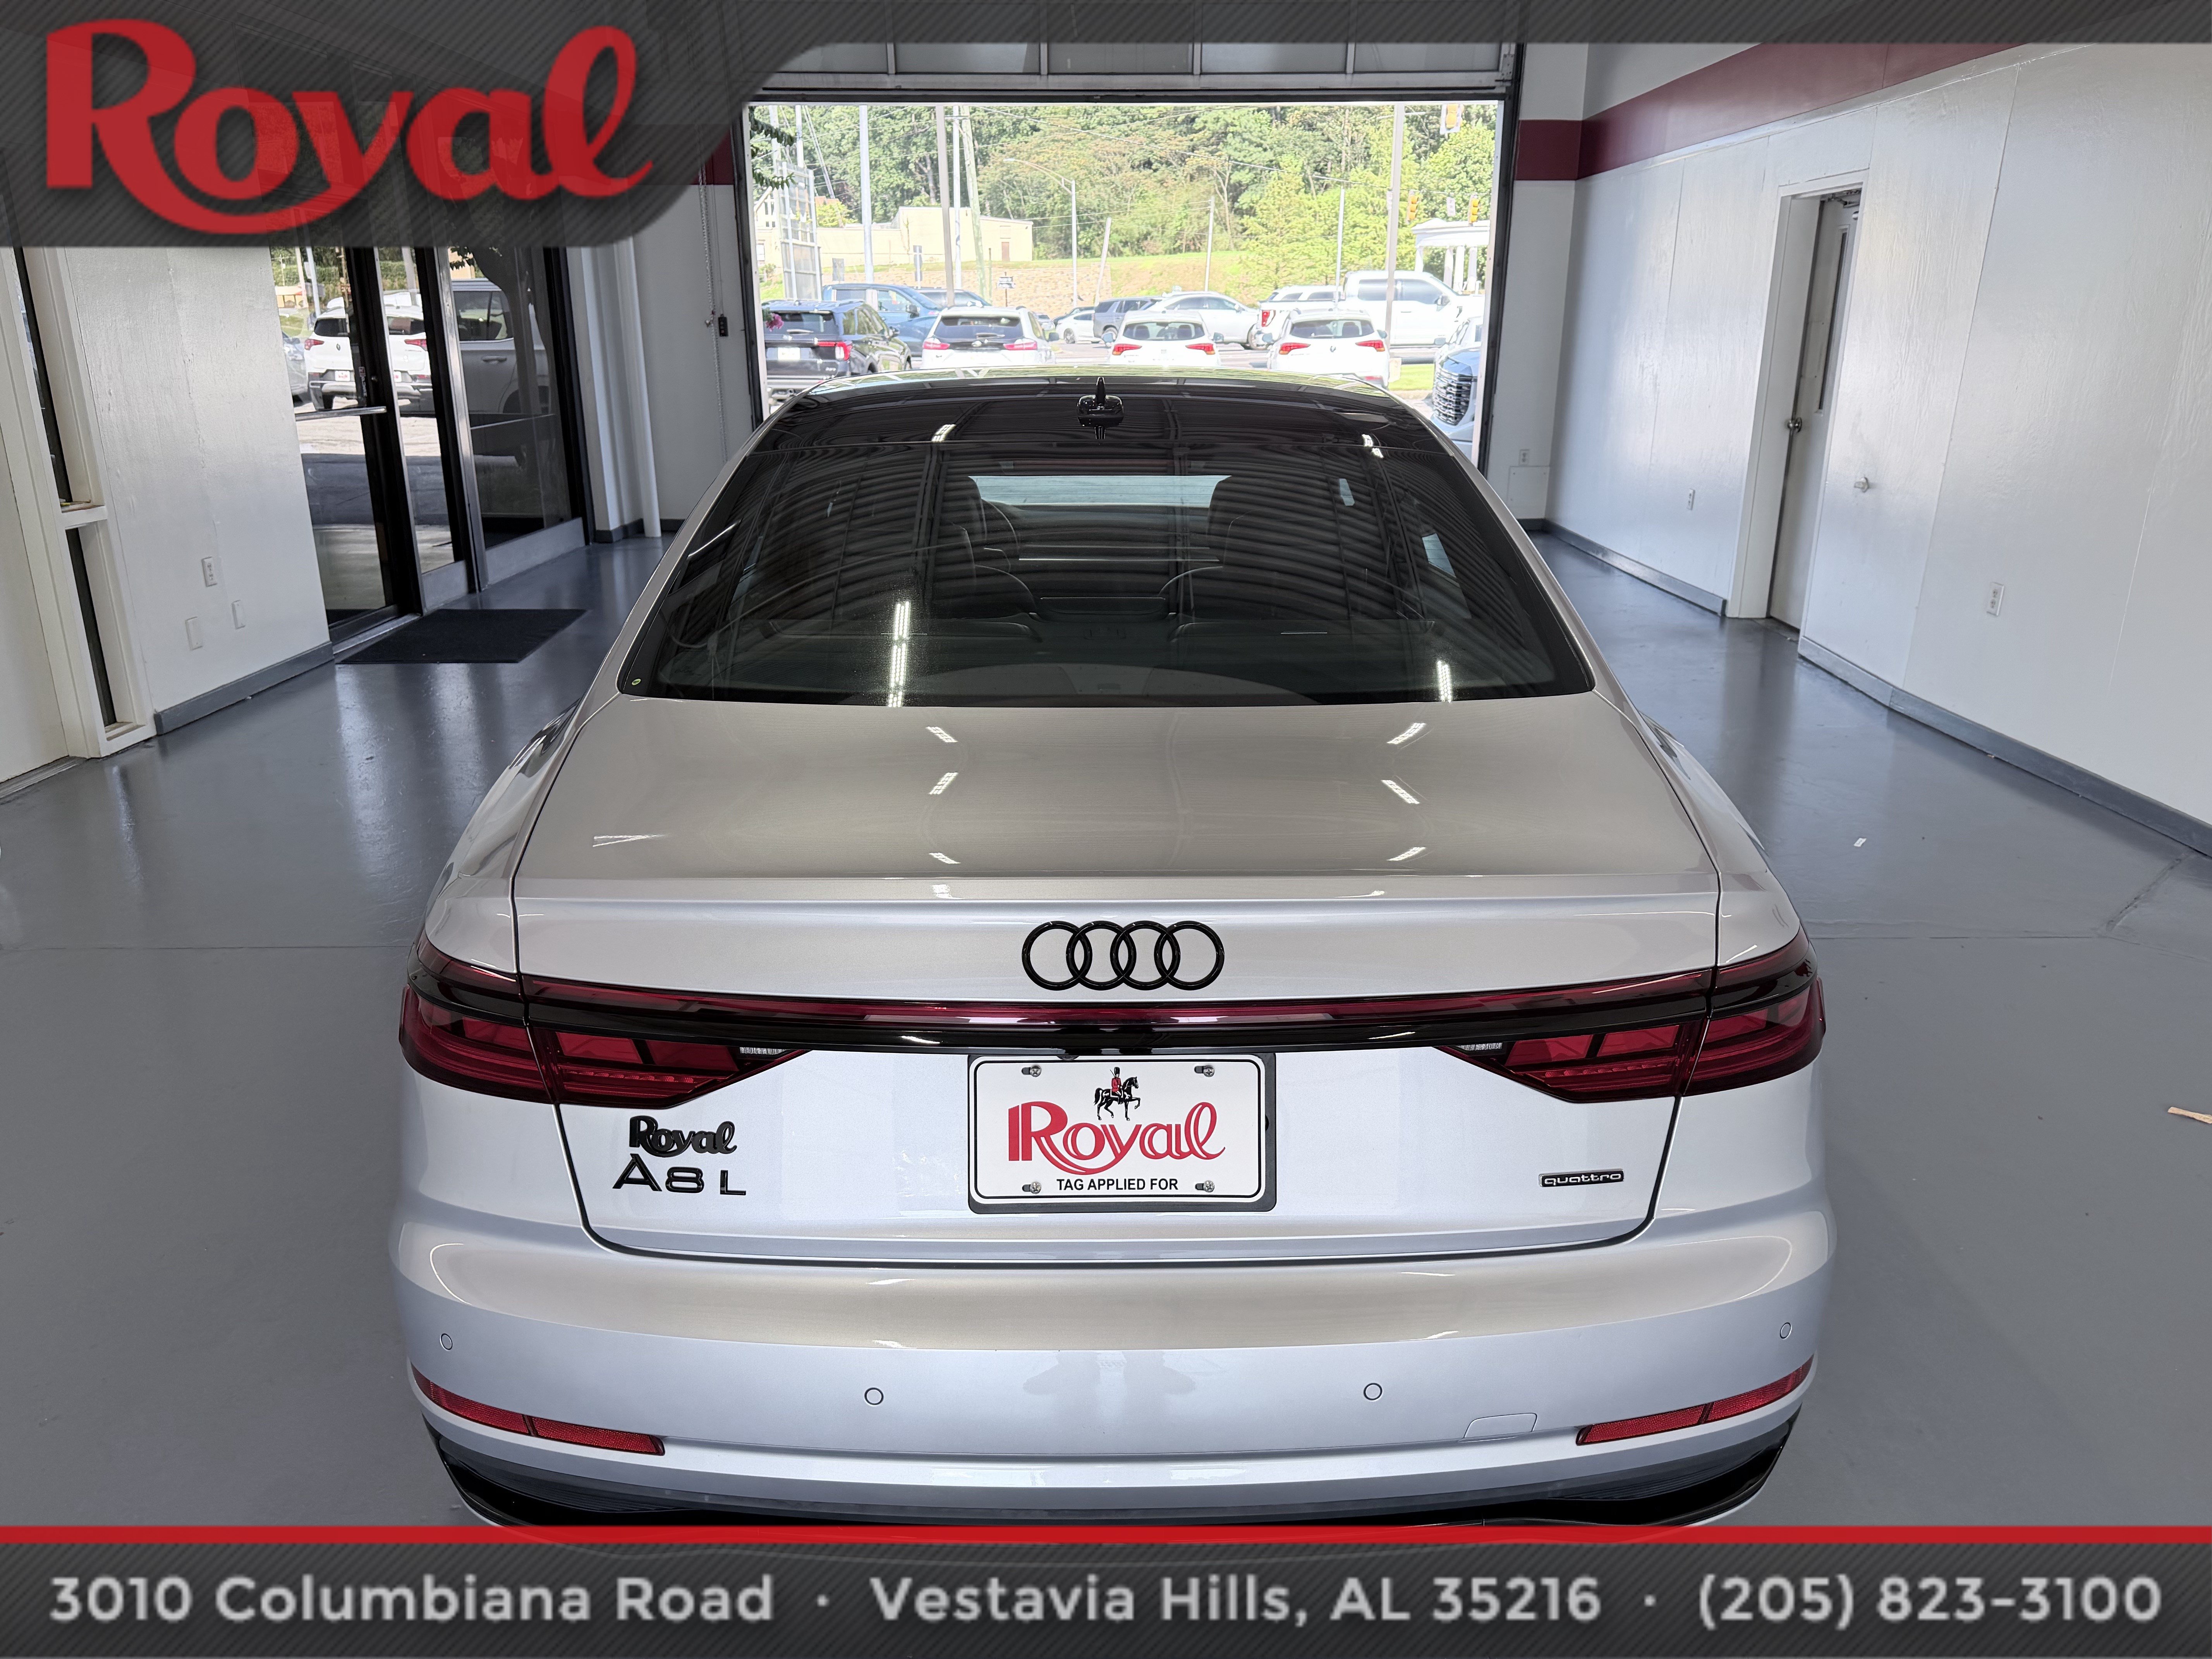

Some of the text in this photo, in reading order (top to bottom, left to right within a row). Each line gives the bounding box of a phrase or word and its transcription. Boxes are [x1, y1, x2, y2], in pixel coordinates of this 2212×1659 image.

[629, 1115, 737, 1158] Royal
[1008, 1101, 1226, 1175] Royal
[612, 1153, 747, 1195] A8 L
[1056, 1178, 1179, 1190] TAG APPLIED FOR
[1544, 1173, 1621, 1186] quattro
